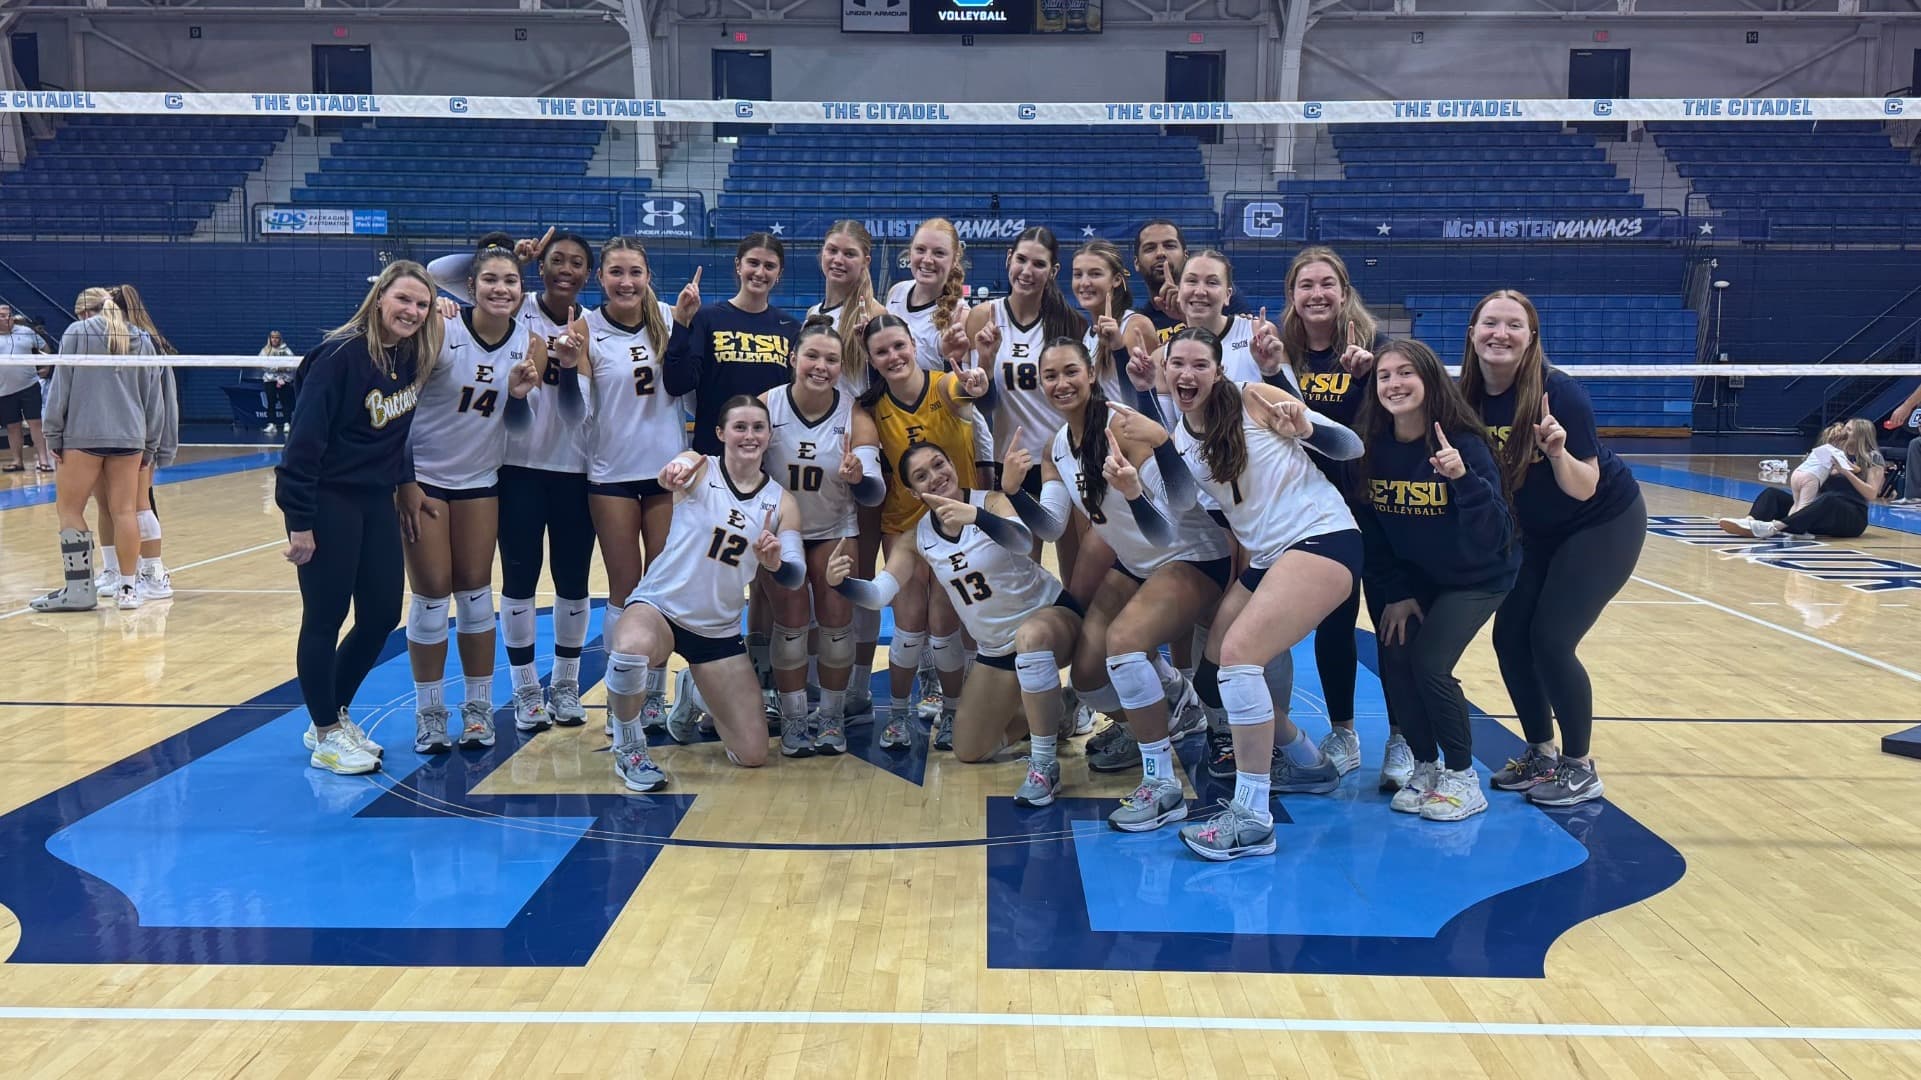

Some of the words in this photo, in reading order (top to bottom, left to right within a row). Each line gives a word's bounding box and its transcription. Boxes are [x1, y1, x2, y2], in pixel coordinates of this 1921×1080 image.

[939, 10, 1008, 21] VOLLEYBALL
[12, 91, 96, 109] CITADEL
[164, 94, 183, 109] C
[252, 94, 291, 111] THE
[296, 94, 381, 112] CITADEL
[449, 97, 468, 113] C
[537, 98, 576, 115] THE
[582, 99, 666, 117] CITADEL
[1393, 100, 1431, 117] THE
[1437, 100, 1523, 117] CITADEL
[1593, 99, 1612, 116] C
[1683, 99, 1722, 116] THE
[1727, 99, 1813, 116] CITADEL
[1884, 99, 1904, 115] C
[735, 101, 753, 118] C
[822, 102, 861, 119] THE
[866, 103, 950, 120] CITADEL
[1018, 103, 1036, 120] C
[1105, 103, 1144, 120] THE
[1149, 103, 1233, 120] CITADEL
[1303, 102, 1322, 118] C
[865, 218, 917, 237] ALIST
[952, 218, 1026, 239] ANIACS
[1243, 202, 1284, 238] C
[712, 330, 790, 357] ETSU
[1011, 342, 1030, 358] E
[629, 344, 649, 362] E
[713, 350, 788, 368] VOLLEYBALL
[475, 364, 494, 384] E
[633, 366, 655, 397] 2
[1002, 362, 1038, 391] 18
[1299, 372, 1352, 395] TSU
[457, 386, 499, 418] 14
[797, 441, 817, 460] E
[787, 464, 824, 492] 10
[1368, 479, 1449, 507] ETSU
[726, 508, 746, 530] E
[1374, 503, 1447, 517] VOLLEYBALL
[706, 527, 749, 568] 12
[948, 551, 969, 572] E
[949, 570, 993, 606] 13
